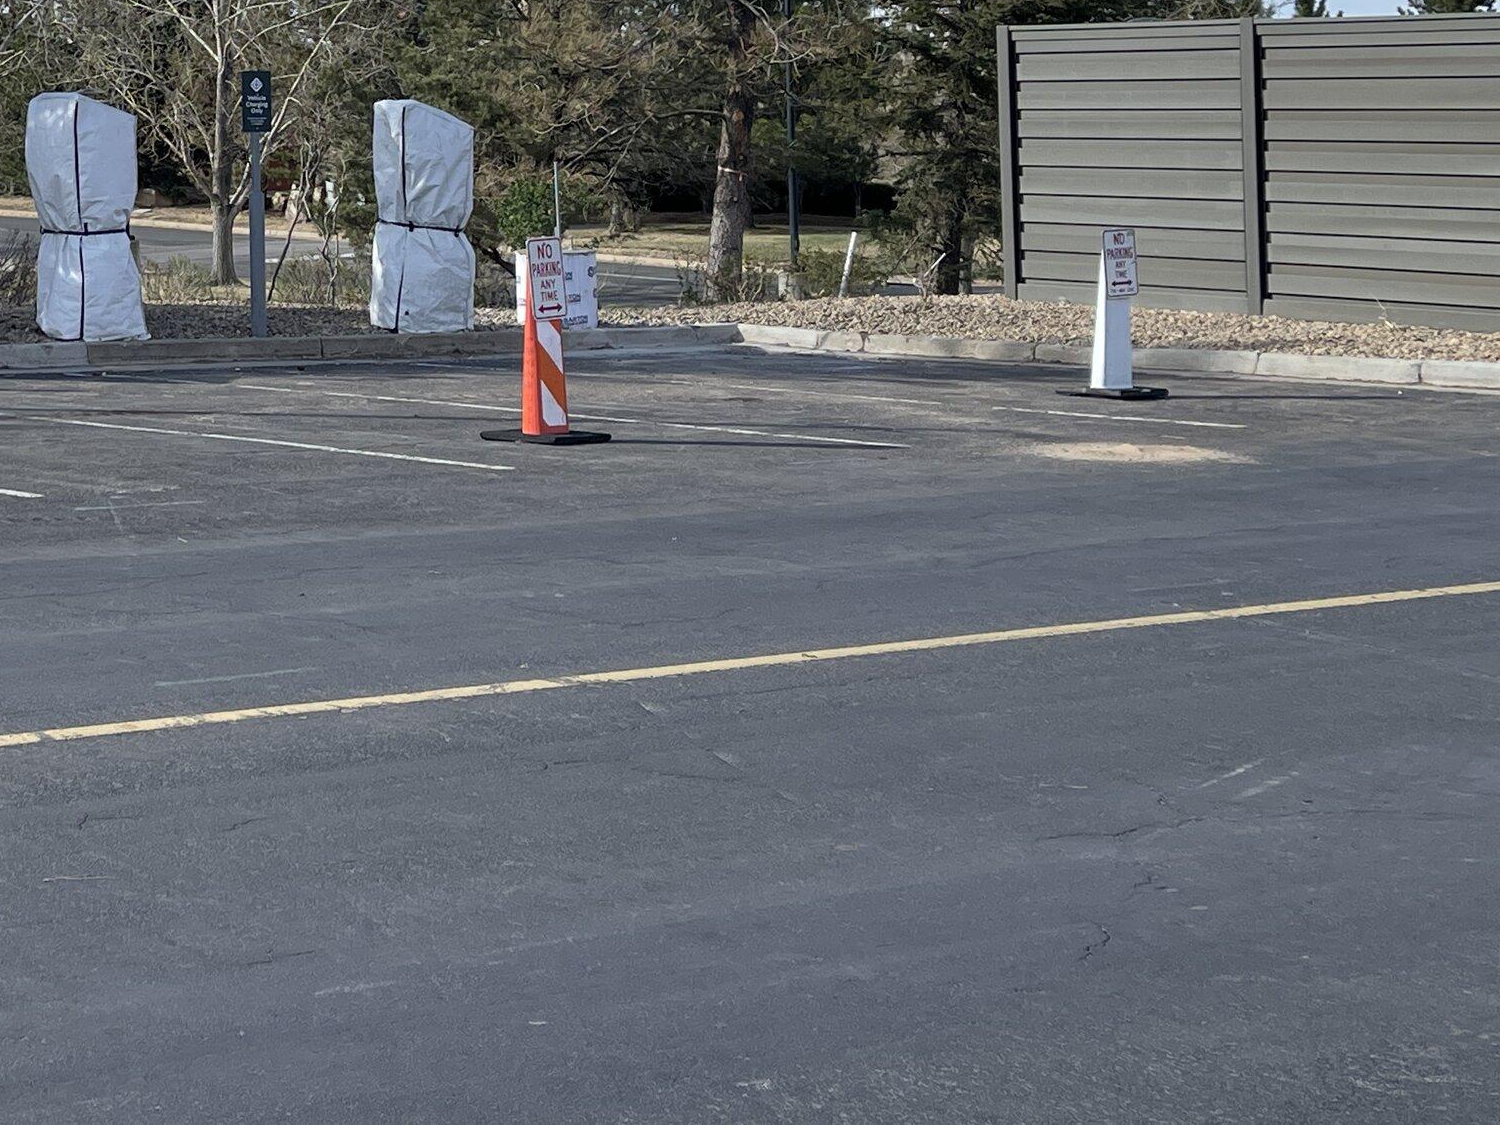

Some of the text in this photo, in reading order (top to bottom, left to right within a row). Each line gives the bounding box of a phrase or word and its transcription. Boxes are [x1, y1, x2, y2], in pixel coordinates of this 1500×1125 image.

[1112, 233, 1125, 245] NO
[537, 242, 553, 259] NO
[1106, 246, 1134, 260] PARKING
[531, 261, 562, 277] PARKING
[540, 278, 556, 290] ANY
[540, 290, 559, 302] TIME
